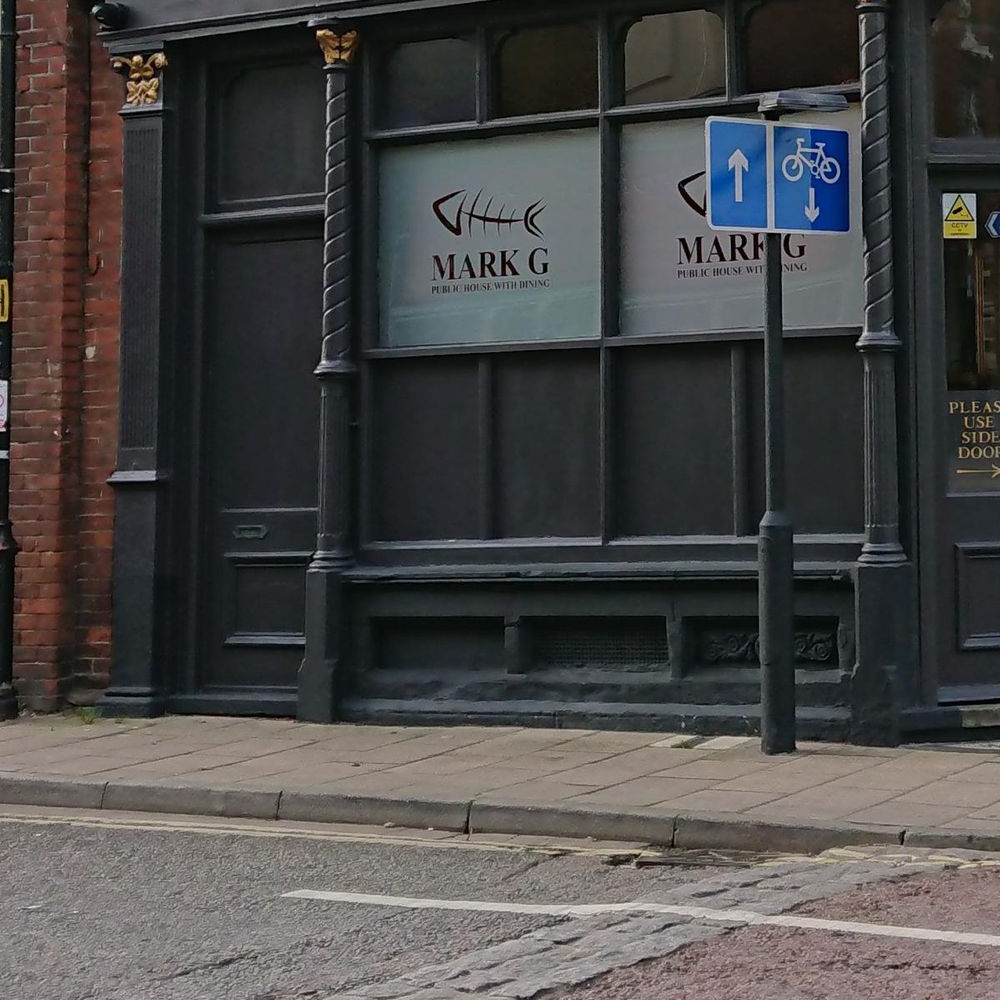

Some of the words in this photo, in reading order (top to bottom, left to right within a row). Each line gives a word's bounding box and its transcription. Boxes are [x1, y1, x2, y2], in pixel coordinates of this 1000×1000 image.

[783, 232, 807, 259] G
[432, 249, 520, 281] MARK
[528, 247, 550, 275] G
[677, 268, 710, 279] PUBLIC
[712, 266, 743, 277] HOUSE
[745, 265, 763, 274] WIT
[431, 284, 461, 295] PUBLIC
[463, 282, 492, 293] HOUSE
[494, 280, 517, 290] WITH
[519, 279, 550, 289] DINING
[963, 415, 994, 429] USE
[961, 431, 1000, 444] SIDE
